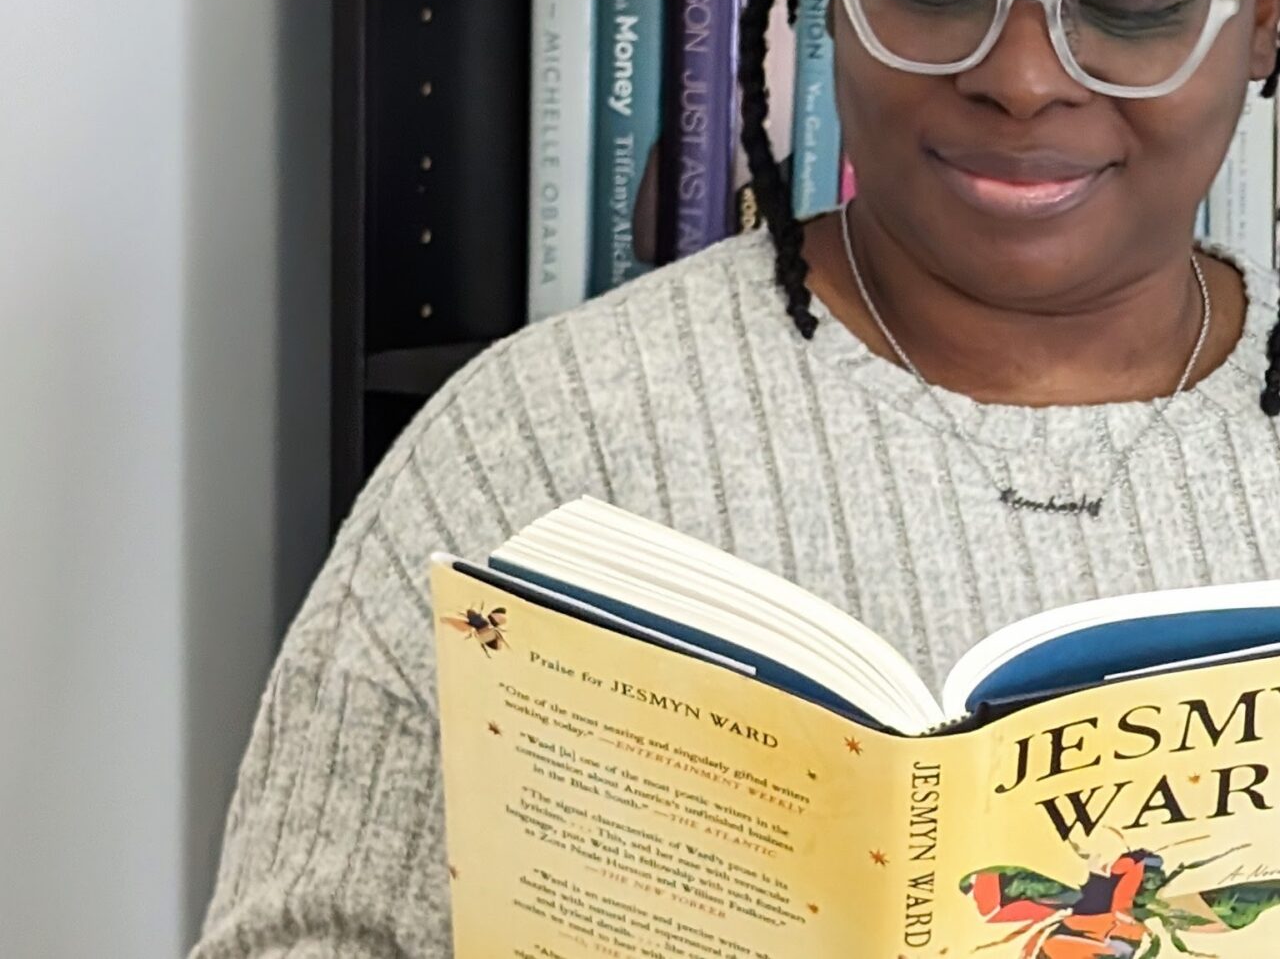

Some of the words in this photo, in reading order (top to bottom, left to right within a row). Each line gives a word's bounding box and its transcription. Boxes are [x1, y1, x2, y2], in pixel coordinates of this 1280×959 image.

[540, 24, 564, 170] MICHELLE
[607, 15, 640, 117] Money
[680, 69, 712, 149] JUST
[607, 132, 634, 213] Tiffany
[679, 156, 707, 200] AS
[538, 183, 560, 286] OBAMA
[529, 651, 575, 677] Praise
[581, 671, 603, 688] for
[610, 679, 701, 720] JESMYN
[710, 712, 778, 748] WARD
[504, 699, 549, 724] working
[748, 787, 806, 815] WEEKLY
[535, 698, 547, 707] of
[551, 703, 568, 716] the
[572, 712, 599, 727] most
[604, 724, 645, 745] searing
[649, 739, 669, 751] and
[673, 746, 730, 773] singularly
[734, 767, 768, 787] gifted
[772, 783, 810, 804] writers
[515, 746, 584, 776] conversation
[588, 772, 619, 788] about
[685, 806, 744, 833] unfinished
[749, 828, 795, 852] business
[533, 764, 544, 775] in
[549, 770, 565, 782] the
[570, 778, 600, 795] Black
[704, 825, 778, 859] ATLANTIC
[579, 756, 600, 768] one
[605, 765, 618, 774] of
[621, 769, 638, 781] the
[643, 778, 670, 792] most
[675, 789, 709, 807] poetic
[714, 802, 752, 822] writers
[757, 817, 768, 829] in
[772, 823, 789, 836] the
[908, 761, 942, 861] JESMYN
[555, 801, 588, 818] signal
[592, 813, 664, 843] characteristic
[668, 841, 681, 850] of
[775, 878, 788, 890] its
[591, 838, 619, 856] Ward
[624, 850, 635, 860] in
[639, 855, 696, 882] fellowship
[700, 877, 724, 892] with
[728, 889, 752, 903] such
[606, 858, 652, 880] Hurston
[657, 876, 677, 888] and
[682, 883, 725, 905] William
[631, 840, 651, 853] and
[656, 847, 674, 861] her
[706, 866, 730, 881] with
[734, 877, 790, 904] vernacular
[1217, 864, 1245, 885] A
[536, 896, 556, 908] and
[559, 903, 593, 923] lyrical
[561, 892, 585, 908] with
[631, 919, 651, 931] and
[652, 913, 673, 926] and
[676, 921, 715, 941] precise
[719, 937, 751, 955] writer
[671, 893, 727, 919] YORKER
[904, 871, 935, 948] WARD
